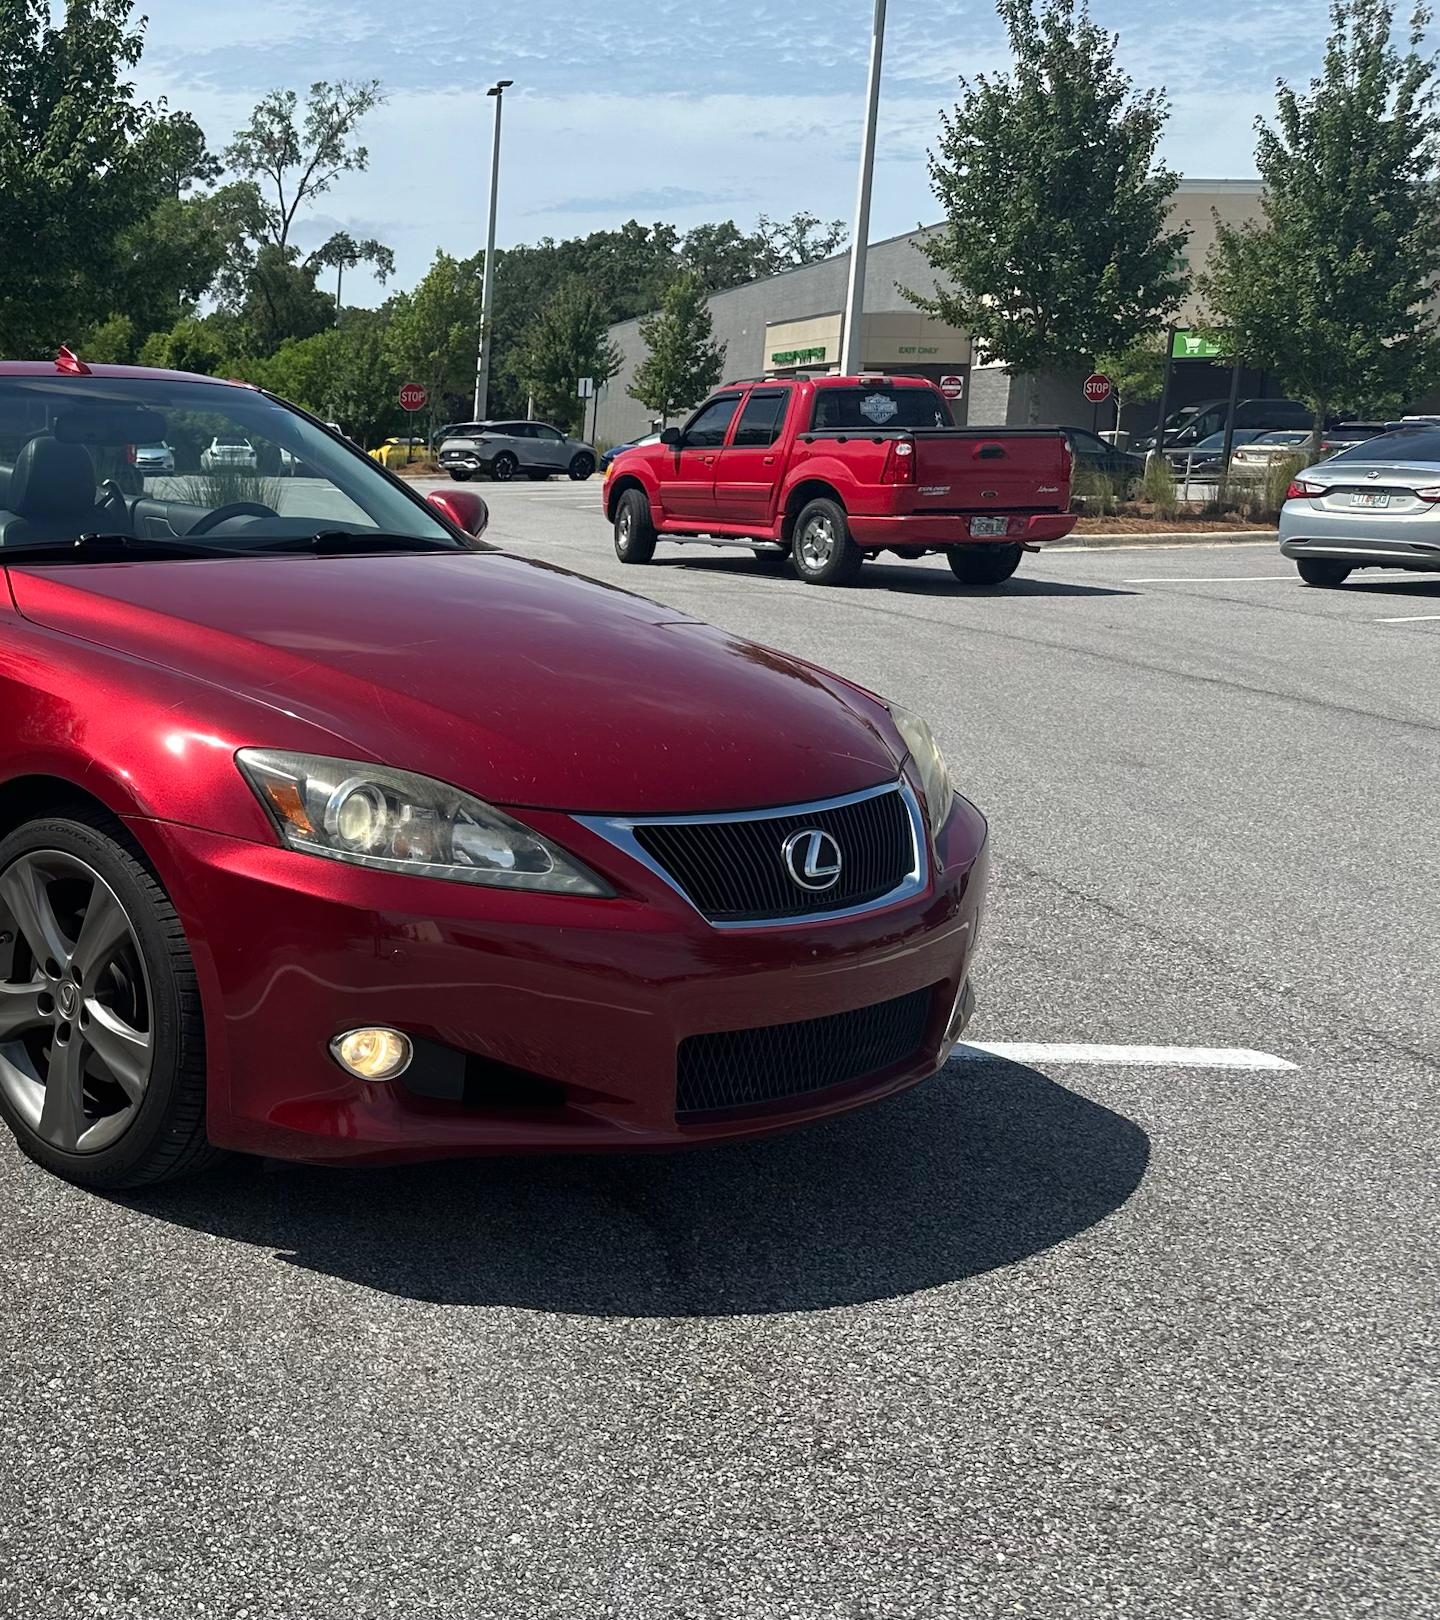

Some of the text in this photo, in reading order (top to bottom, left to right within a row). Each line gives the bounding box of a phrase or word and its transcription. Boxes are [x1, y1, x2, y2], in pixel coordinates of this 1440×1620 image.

[918, 346, 939, 354] ONLY
[1086, 382, 1109, 394] STOP
[401, 391, 425, 402] STOP
